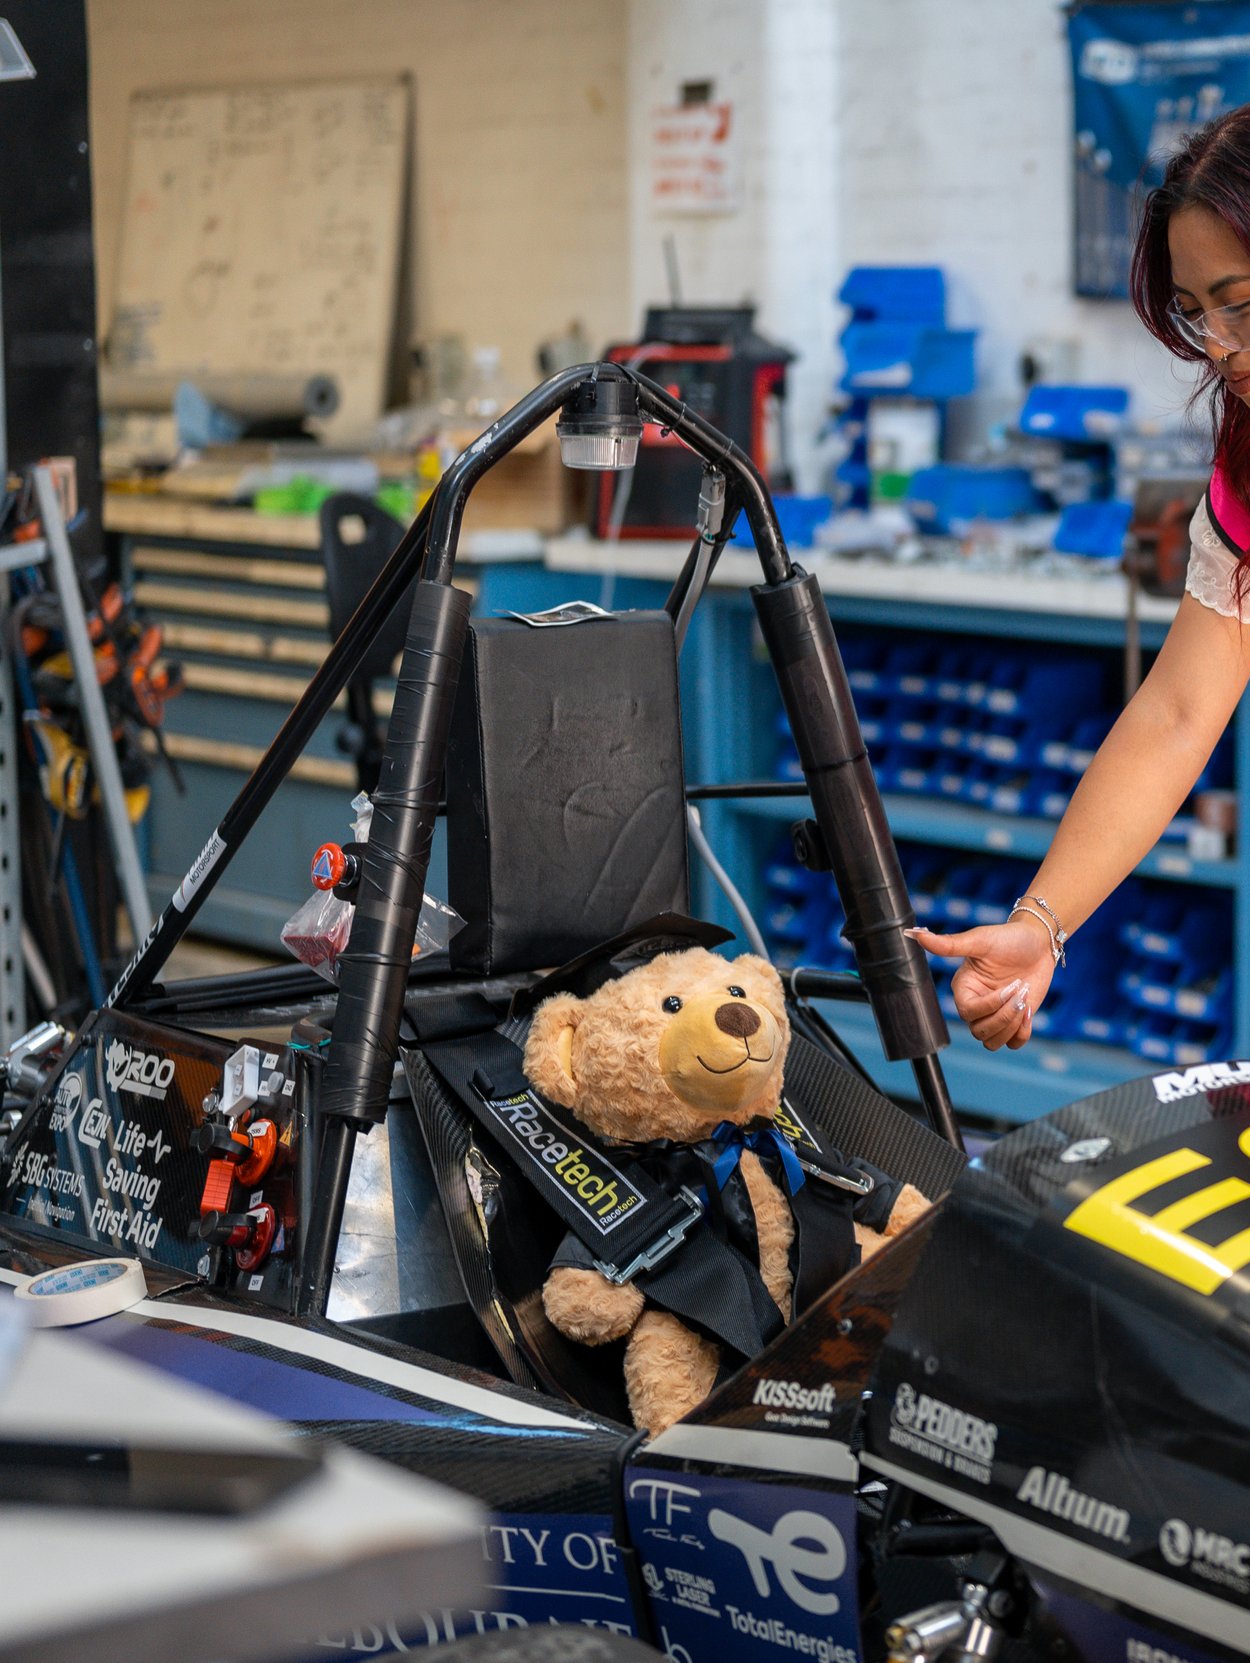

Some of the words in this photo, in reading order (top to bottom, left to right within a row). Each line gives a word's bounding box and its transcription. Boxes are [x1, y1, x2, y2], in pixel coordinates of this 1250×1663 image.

[189, 838, 220, 886] MOTORSPORT
[490, 1093, 530, 1108] Racetech
[113, 1120, 147, 1158] Life
[500, 1102, 620, 1217] Racetech
[22, 1151, 49, 1187] SBG
[43, 1167, 86, 1198] SYSTEMS
[102, 1157, 161, 1211] Saving
[89, 1198, 128, 1239] First
[125, 1211, 163, 1250] Aid
[599, 1195, 638, 1227] Racetech
[752, 1379, 836, 1413] KISSsoft
[915, 1393, 999, 1461] PEDDERS
[563, 1532, 619, 1575] OF
[725, 1604, 858, 1663] TotalEnergies
